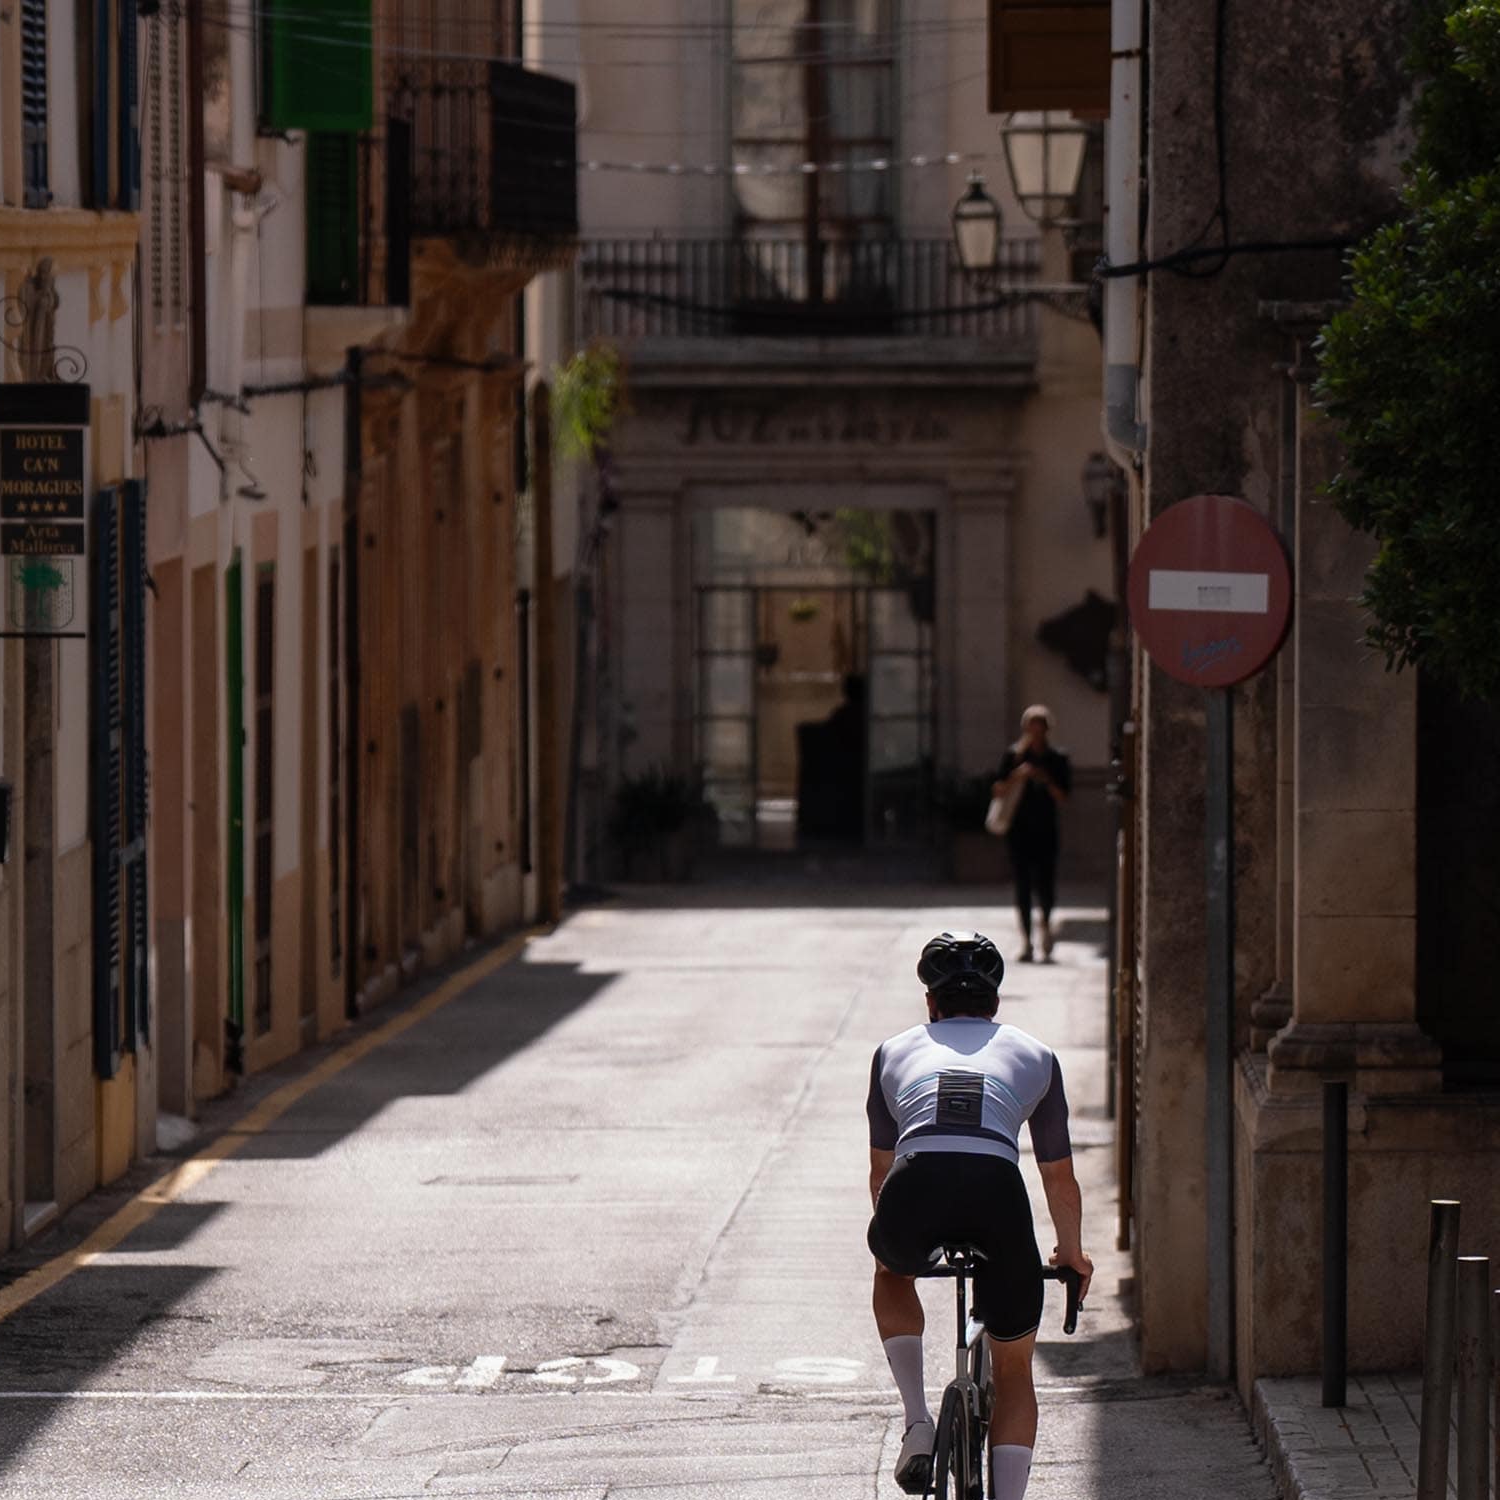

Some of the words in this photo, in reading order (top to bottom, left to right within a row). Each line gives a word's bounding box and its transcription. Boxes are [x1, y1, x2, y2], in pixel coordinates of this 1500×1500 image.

[15, 434, 66, 450] HOTEL
[0, 479, 83, 496] MORAGUES
[11, 539, 76, 554] Mallorca
[398, 1355, 866, 1386] STOP
